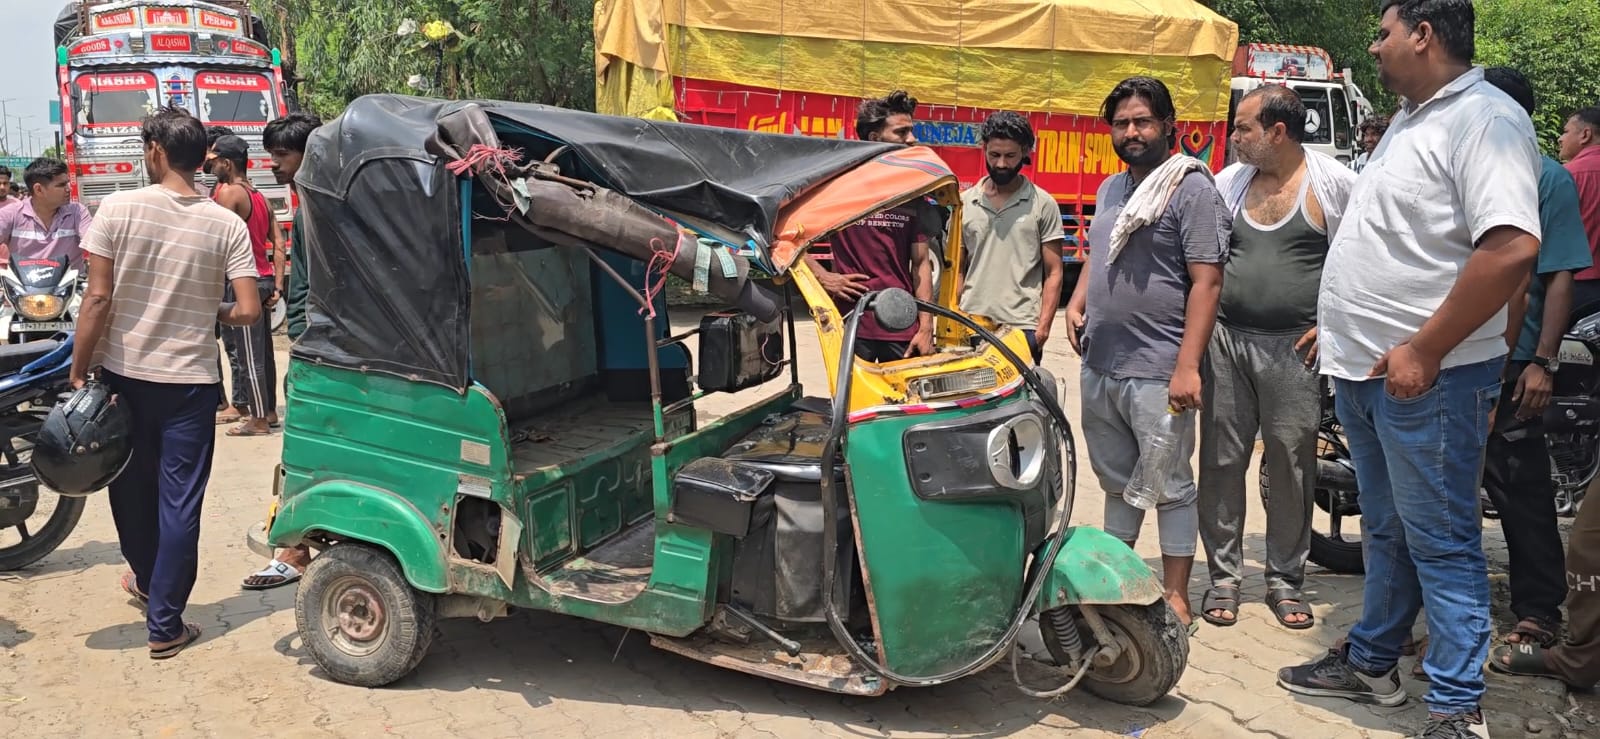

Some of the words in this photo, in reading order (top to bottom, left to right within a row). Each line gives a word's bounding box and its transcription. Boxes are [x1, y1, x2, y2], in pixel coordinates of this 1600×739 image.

[80, 41, 107, 53] GOODS
[203, 77, 258, 87] ALLAH
[1037, 130, 1082, 174] TRAN
[1565, 570, 1600, 592] CH
